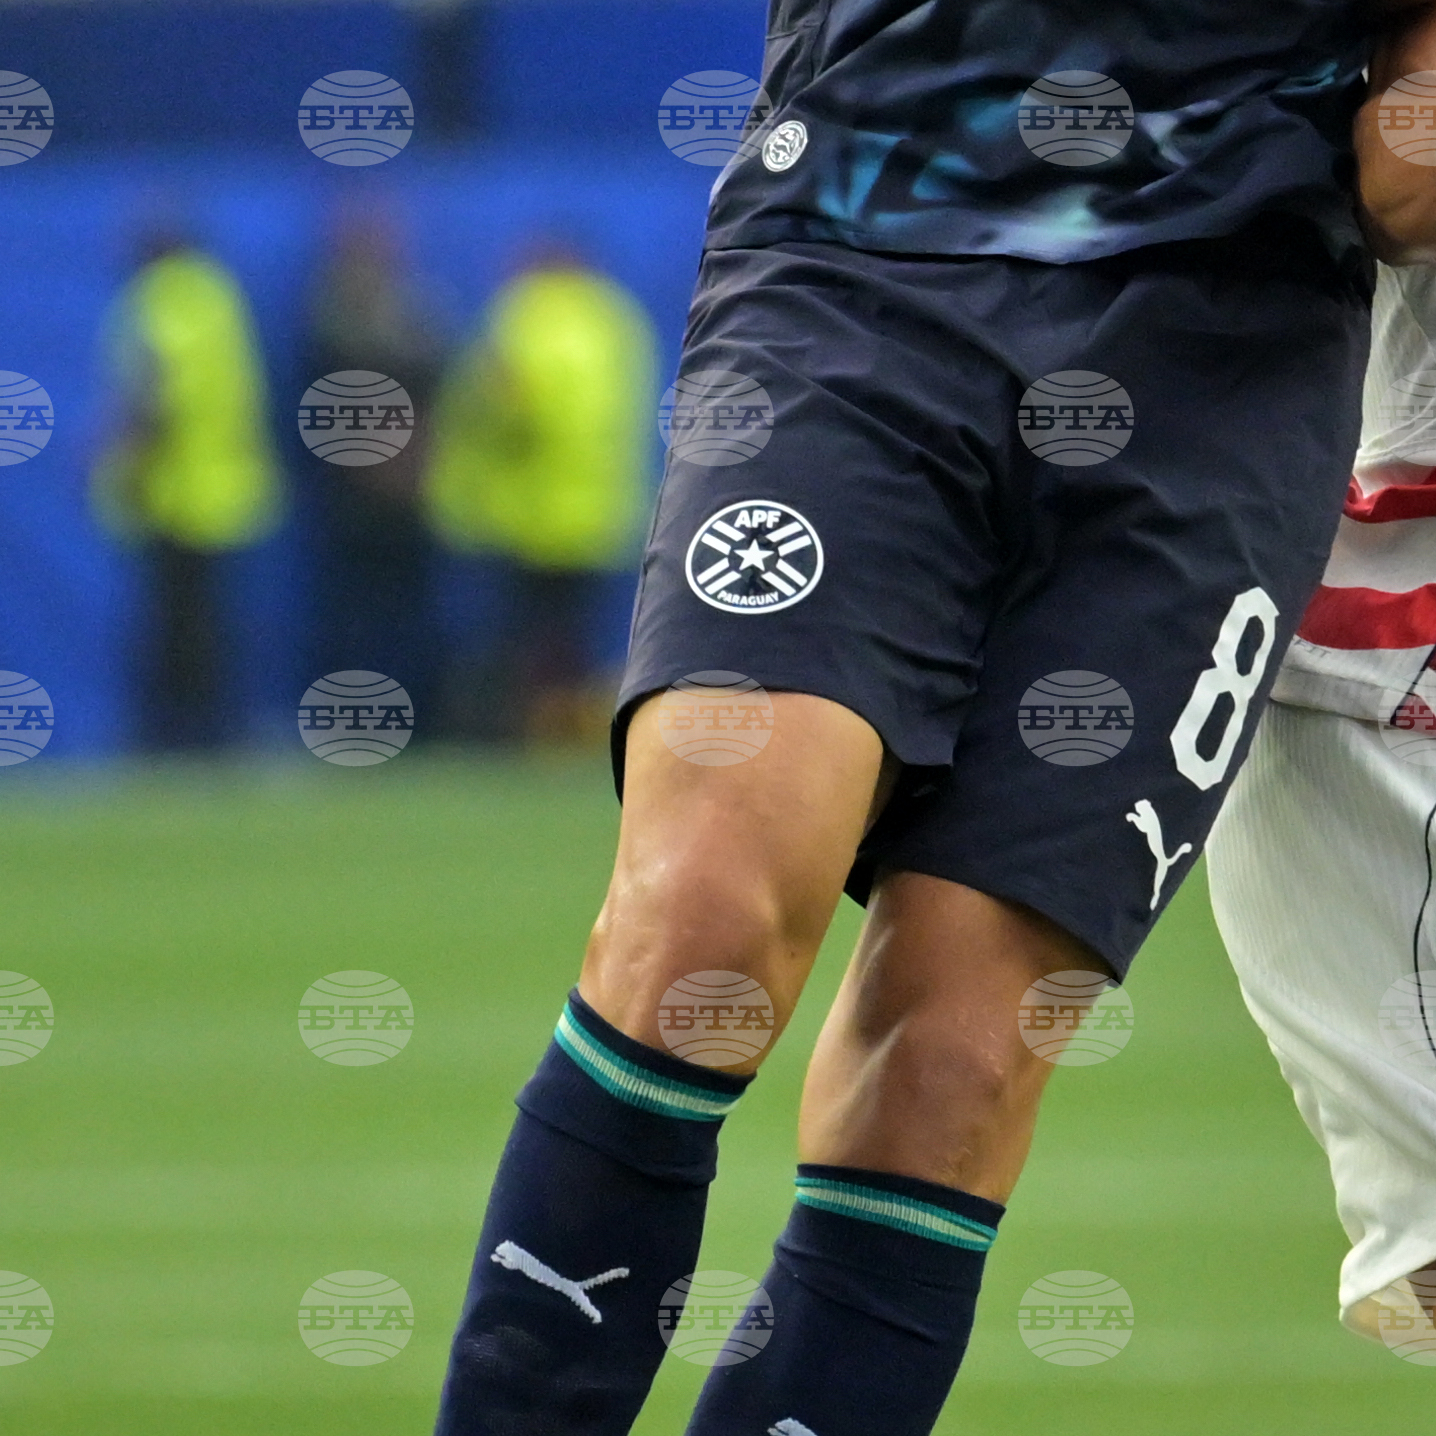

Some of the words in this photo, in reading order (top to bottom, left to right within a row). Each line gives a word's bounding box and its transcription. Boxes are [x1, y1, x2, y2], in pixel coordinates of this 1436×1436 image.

[734, 510, 781, 528] APF
[717, 590, 779, 606] PARAGUAY
[1170, 586, 1280, 791] 8
